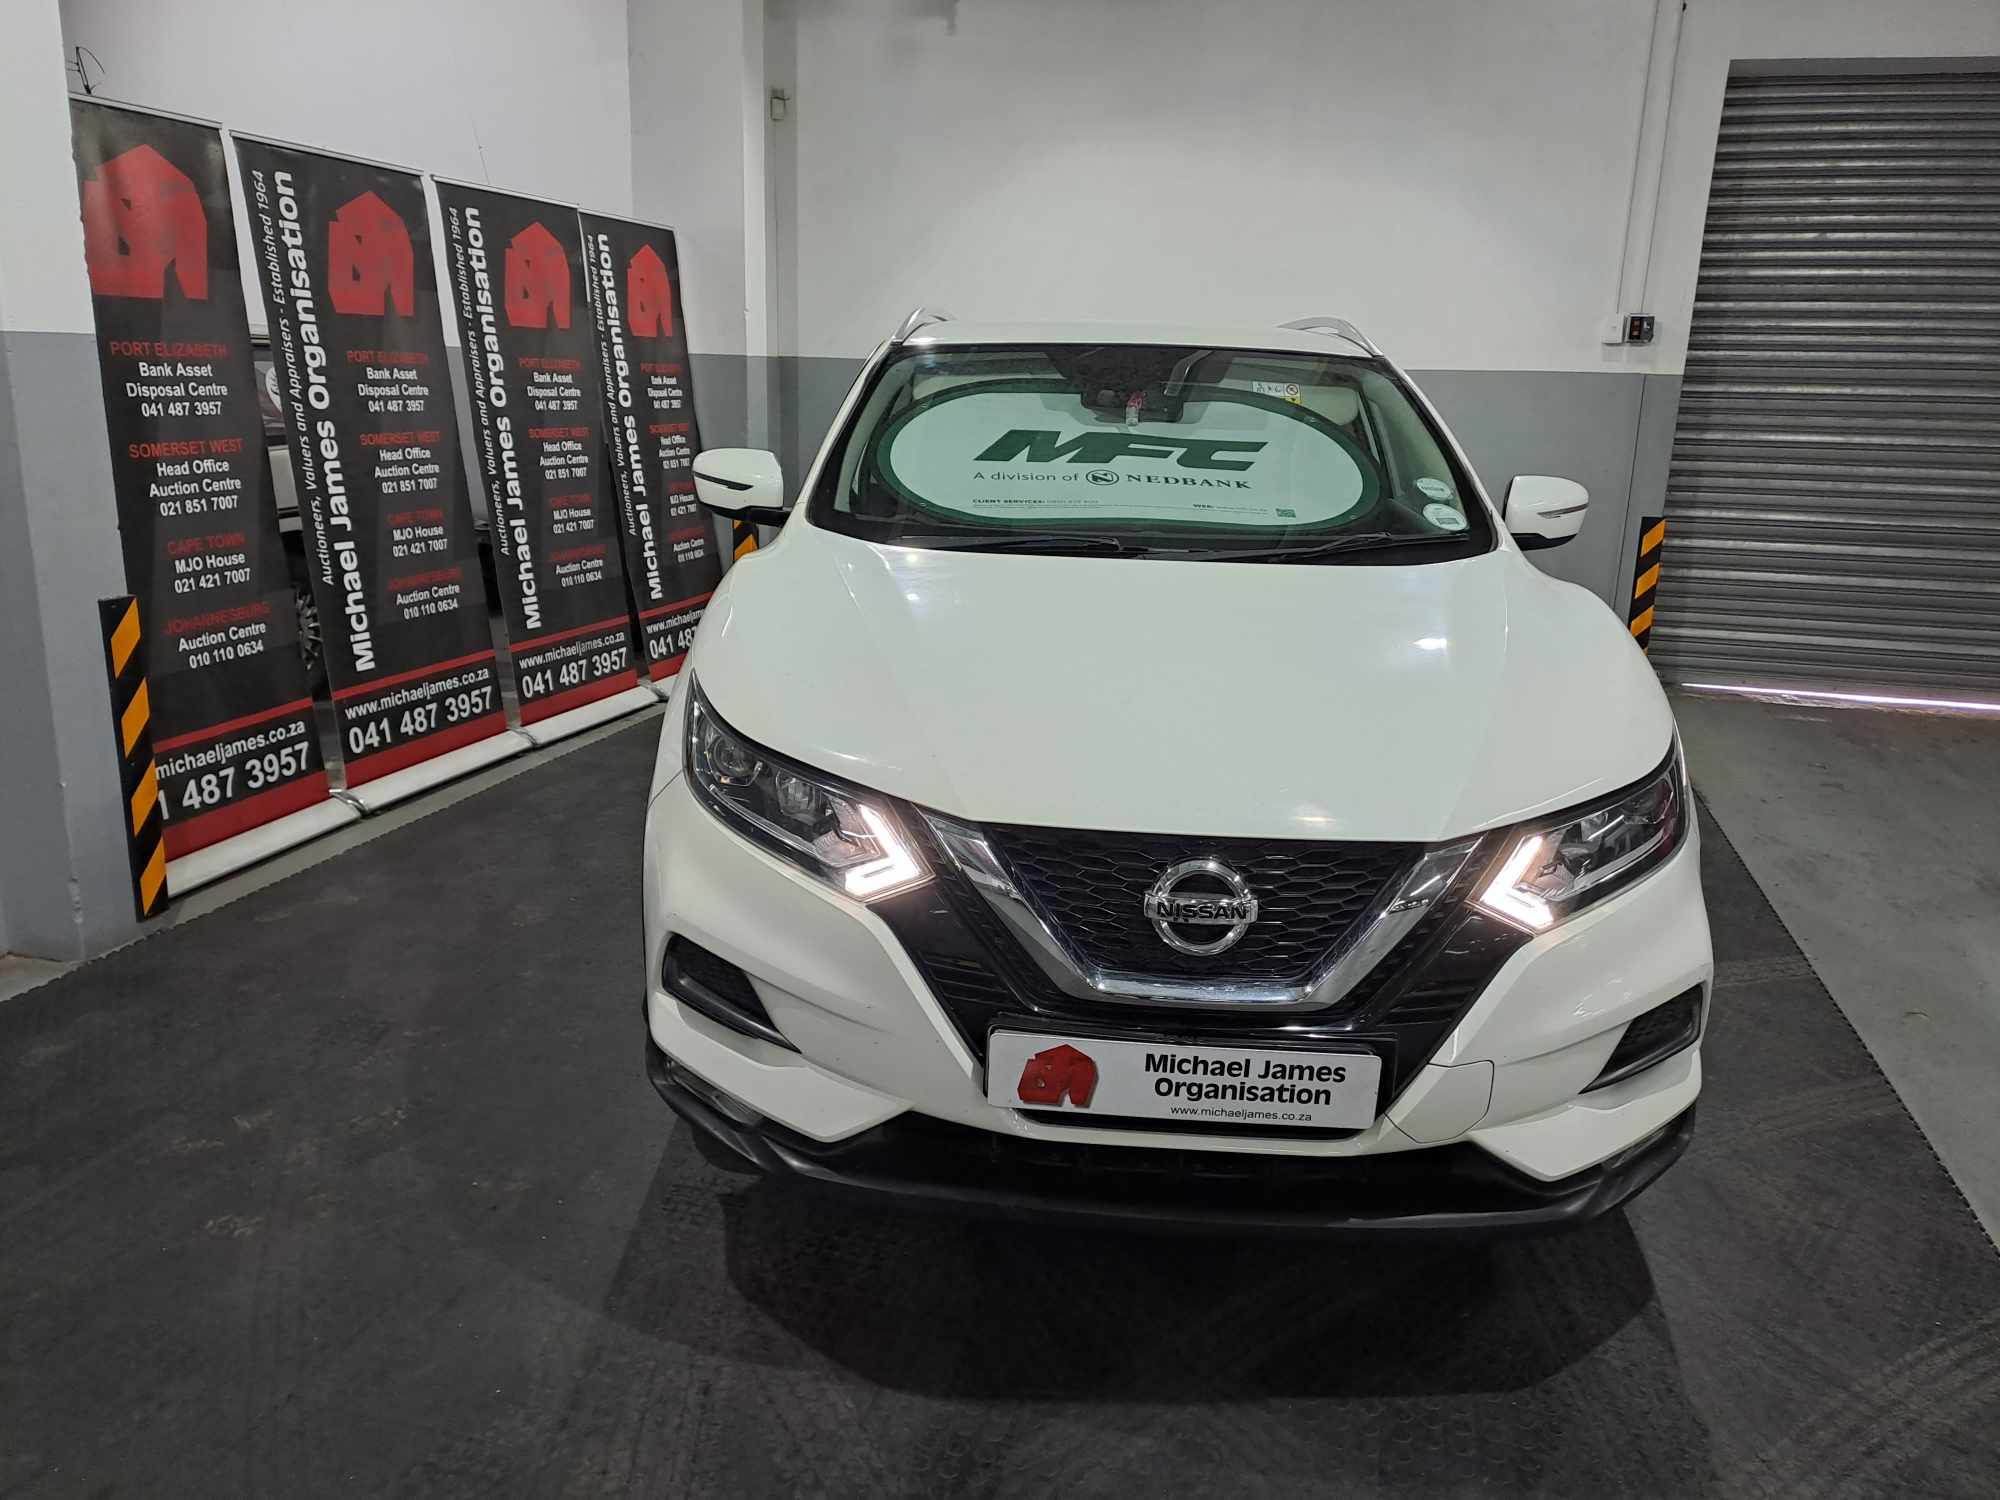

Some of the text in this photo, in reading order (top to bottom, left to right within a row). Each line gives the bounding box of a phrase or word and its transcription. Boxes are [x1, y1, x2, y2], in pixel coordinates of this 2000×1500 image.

[252, 169, 270, 210] 1964
[449, 207, 463, 242] 1964
[259, 214, 286, 305] Established
[453, 244, 473, 319] Established
[110, 342, 153, 357] PORT
[279, 317, 302, 398] Appraisers
[138, 362, 213, 377] Bank Asset
[366, 367, 418, 380] Bank Asset
[466, 330, 485, 398] Appraisers
[600, 341, 616, 400] Appraisers
[126, 382, 229, 400] Disposal Centre
[358, 384, 429, 398] Disposal Centre
[141, 401, 222, 418] 041 487 3957
[291, 401, 309, 434] and
[368, 400, 384, 413] 041
[386, 400, 403, 412] 487
[465, 207, 542, 629] Michael James Organisation
[477, 400, 489, 426] and
[597, 234, 663, 600] Michael James Organisation
[274, 171, 376, 672] Michael James Organisation
[128, 438, 243, 458] SOMERSET WEST
[380, 448, 431, 462] Head Office
[483, 427, 498, 475] Valuers
[973, 429, 1268, 471] MFC
[156, 458, 229, 477] Head Office
[297, 436, 318, 491] Valuers
[374, 463, 440, 478] Auction Centre
[150, 477, 242, 498] Auction Centre
[382, 480, 399, 493] 021
[400, 480, 416, 491] 851
[973, 471, 985, 480] A
[990, 471, 1056, 481] division
[1061, 472, 1081, 481] of
[1126, 474, 1251, 489] NEDBANK
[160, 495, 239, 517] 021 851 7007
[310, 495, 334, 585] Auctioneers,
[393, 526, 443, 541] MJO House
[174, 552, 246, 574] MJO House
[392, 544, 408, 557] 021
[410, 542, 426, 554] 421
[174, 568, 251, 594] 021 421 7007
[396, 584, 460, 605] Auction Centre
[403, 606, 420, 619] 010
[178, 622, 267, 652] Auction Centre
[519, 631, 626, 670] www.michaeljames.co.za
[650, 634, 674, 659] 041
[189, 640, 265, 669] 010 110 0634
[522, 647, 628, 699] 041 487 3957
[345, 667, 490, 720] www.michaeljames.co.za
[348, 686, 492, 754] 041 487 3957
[156, 720, 305, 780] michaeljames.co.za
[182, 766, 235, 810] 487
[244, 741, 309, 789] 3957
[1157, 901, 1249, 919] NISSAN
[1145, 1053, 1346, 1083] Michael James
[1154, 1077, 1332, 1106] Organisation
[1170, 1105, 1312, 1122] www.michaeljames.co.za
